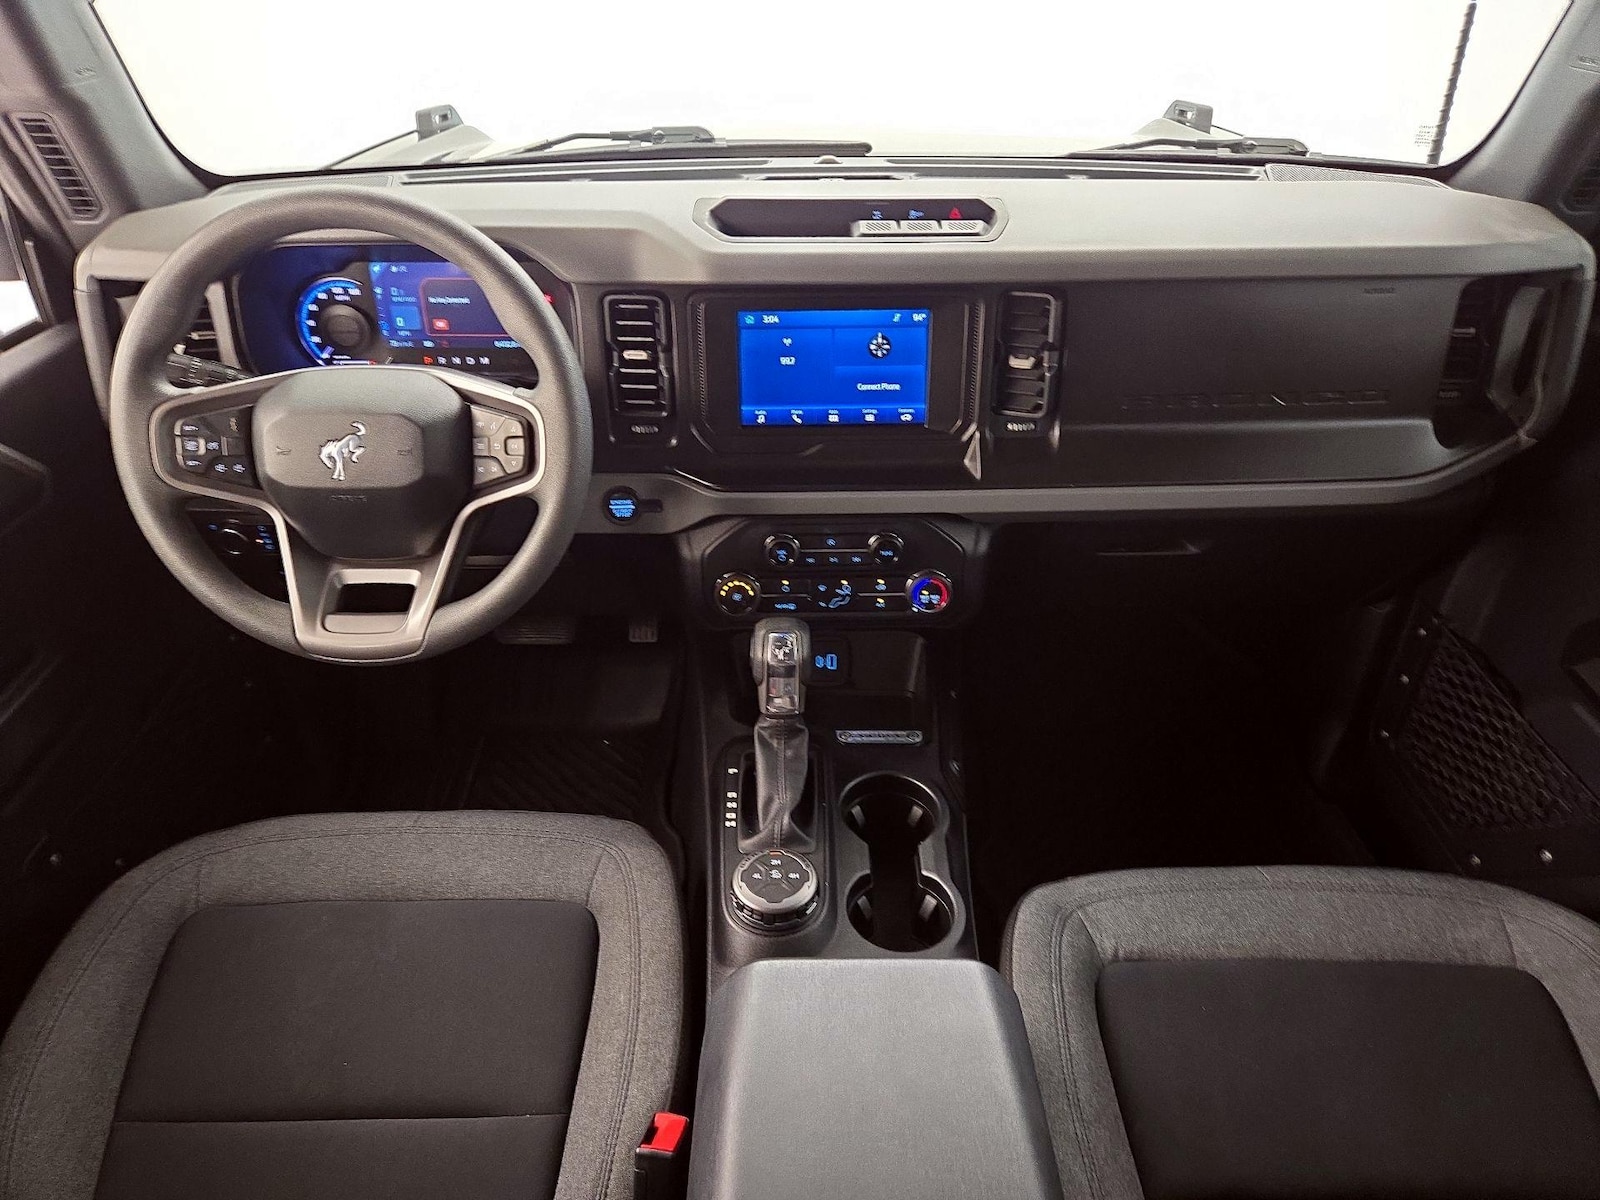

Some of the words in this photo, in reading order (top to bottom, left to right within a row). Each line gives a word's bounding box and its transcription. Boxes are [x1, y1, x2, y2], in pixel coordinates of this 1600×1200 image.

[762, 314, 780, 324] 3:04
[437, 356, 446, 364] R
[450, 356, 462, 364] N
[465, 356, 476, 364] D
[857, 382, 880, 391] Connect
[881, 382, 901, 391] Phone
